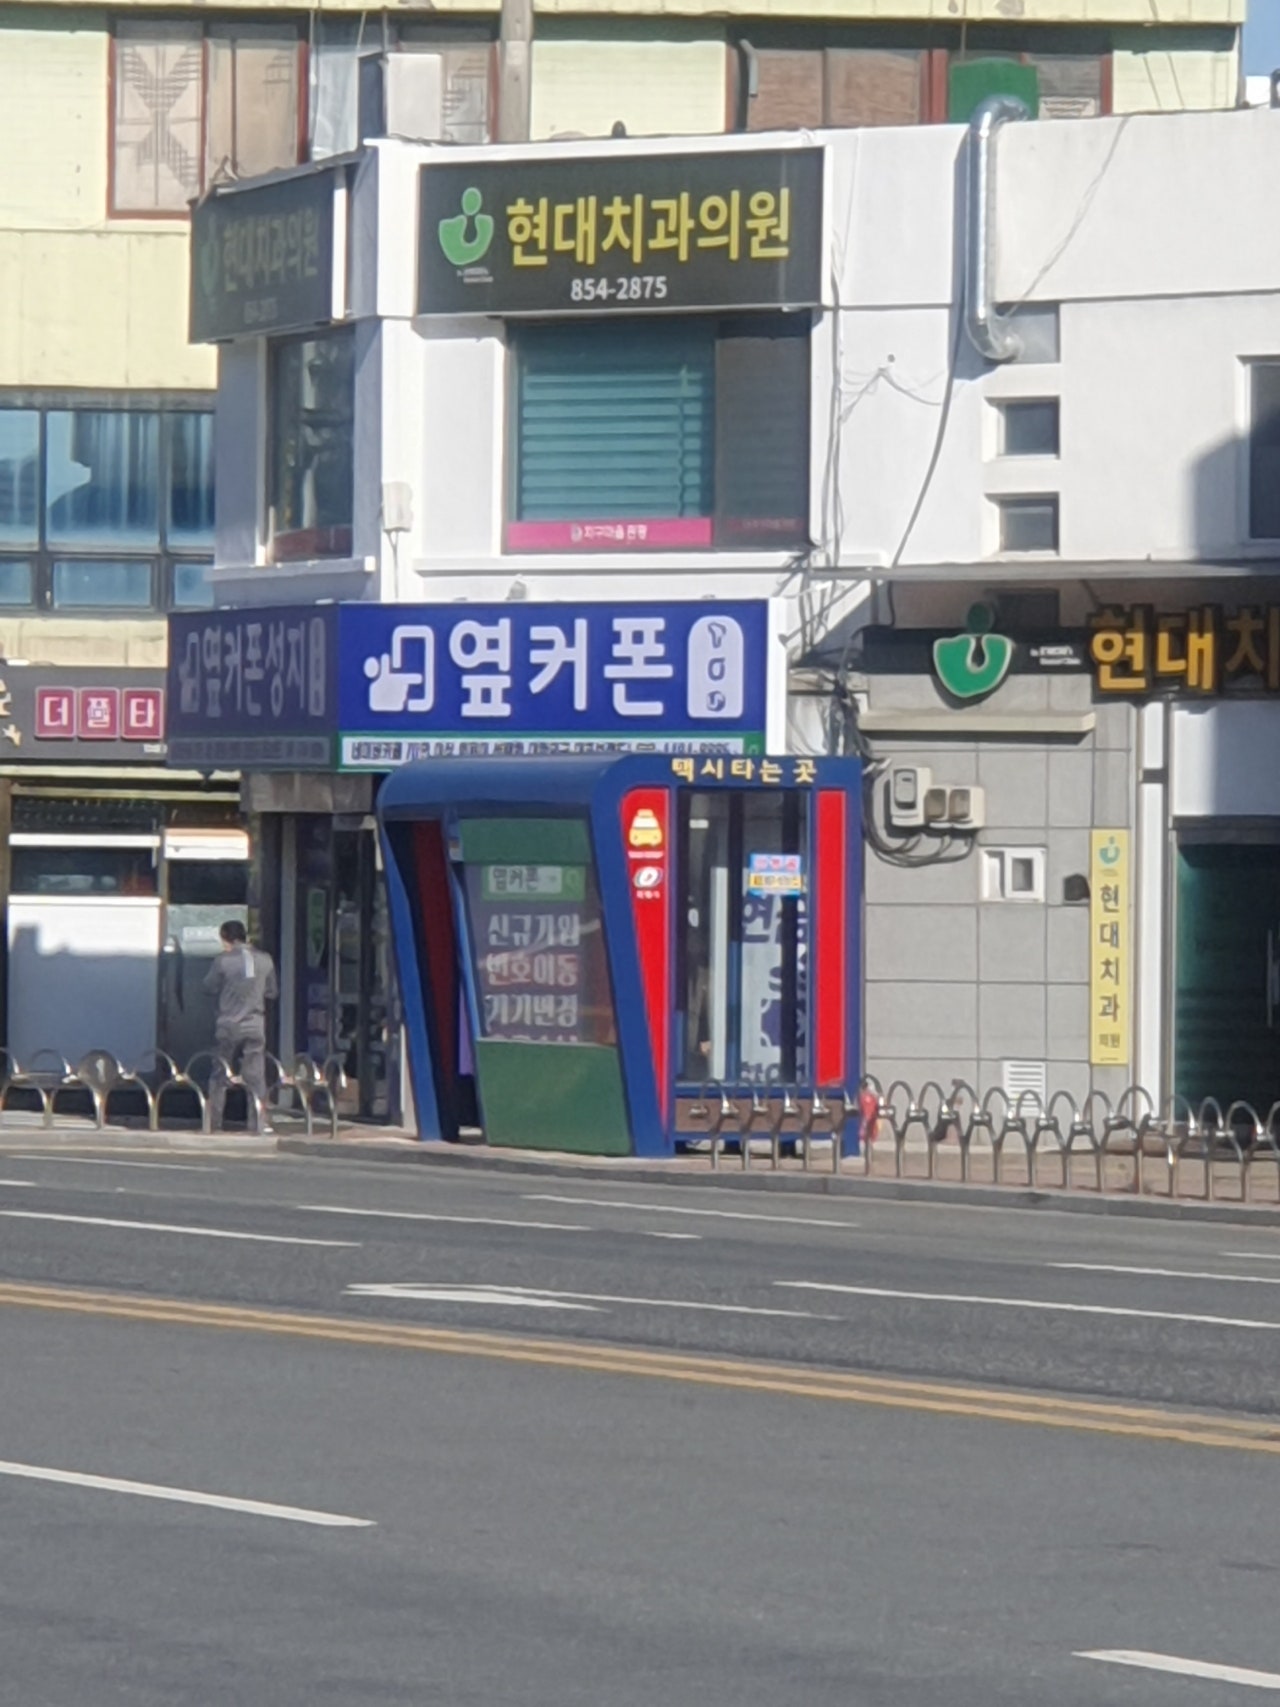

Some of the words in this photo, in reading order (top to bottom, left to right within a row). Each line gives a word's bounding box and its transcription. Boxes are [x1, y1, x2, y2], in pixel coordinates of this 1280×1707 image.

[506, 187, 790, 267] 현대치과의원
[570, 275, 668, 301] 854-2875
[202, 620, 305, 718] 옆커폰성지
[449, 617, 674, 718] 옆커폰
[792, 759, 817, 784] 곳
[487, 912, 580, 946] 신규가입
[485, 952, 579, 987] 번호이동
[1098, 883, 1121, 1023] 현대치과
[485, 993, 578, 1028] 기기변경
